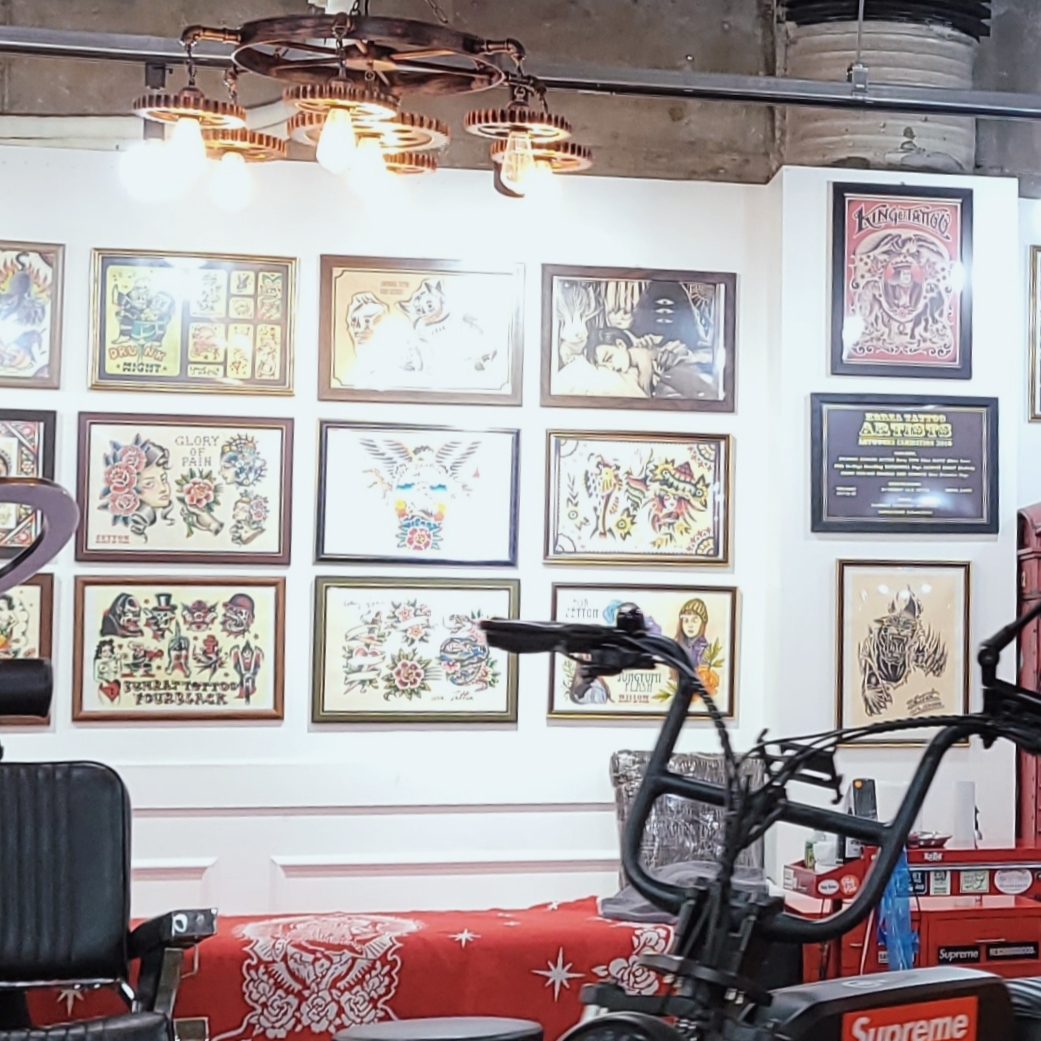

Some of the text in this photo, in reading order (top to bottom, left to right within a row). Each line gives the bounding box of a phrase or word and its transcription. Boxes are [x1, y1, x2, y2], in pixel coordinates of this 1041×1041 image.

[109, 345, 166, 362] DRUNK
[122, 361, 161, 373] NIGHT
[859, 421, 952, 438] ARTISTS
[174, 435, 220, 446] GLORY
[190, 447, 205, 457] OF
[939, 948, 979, 961] Supreme
